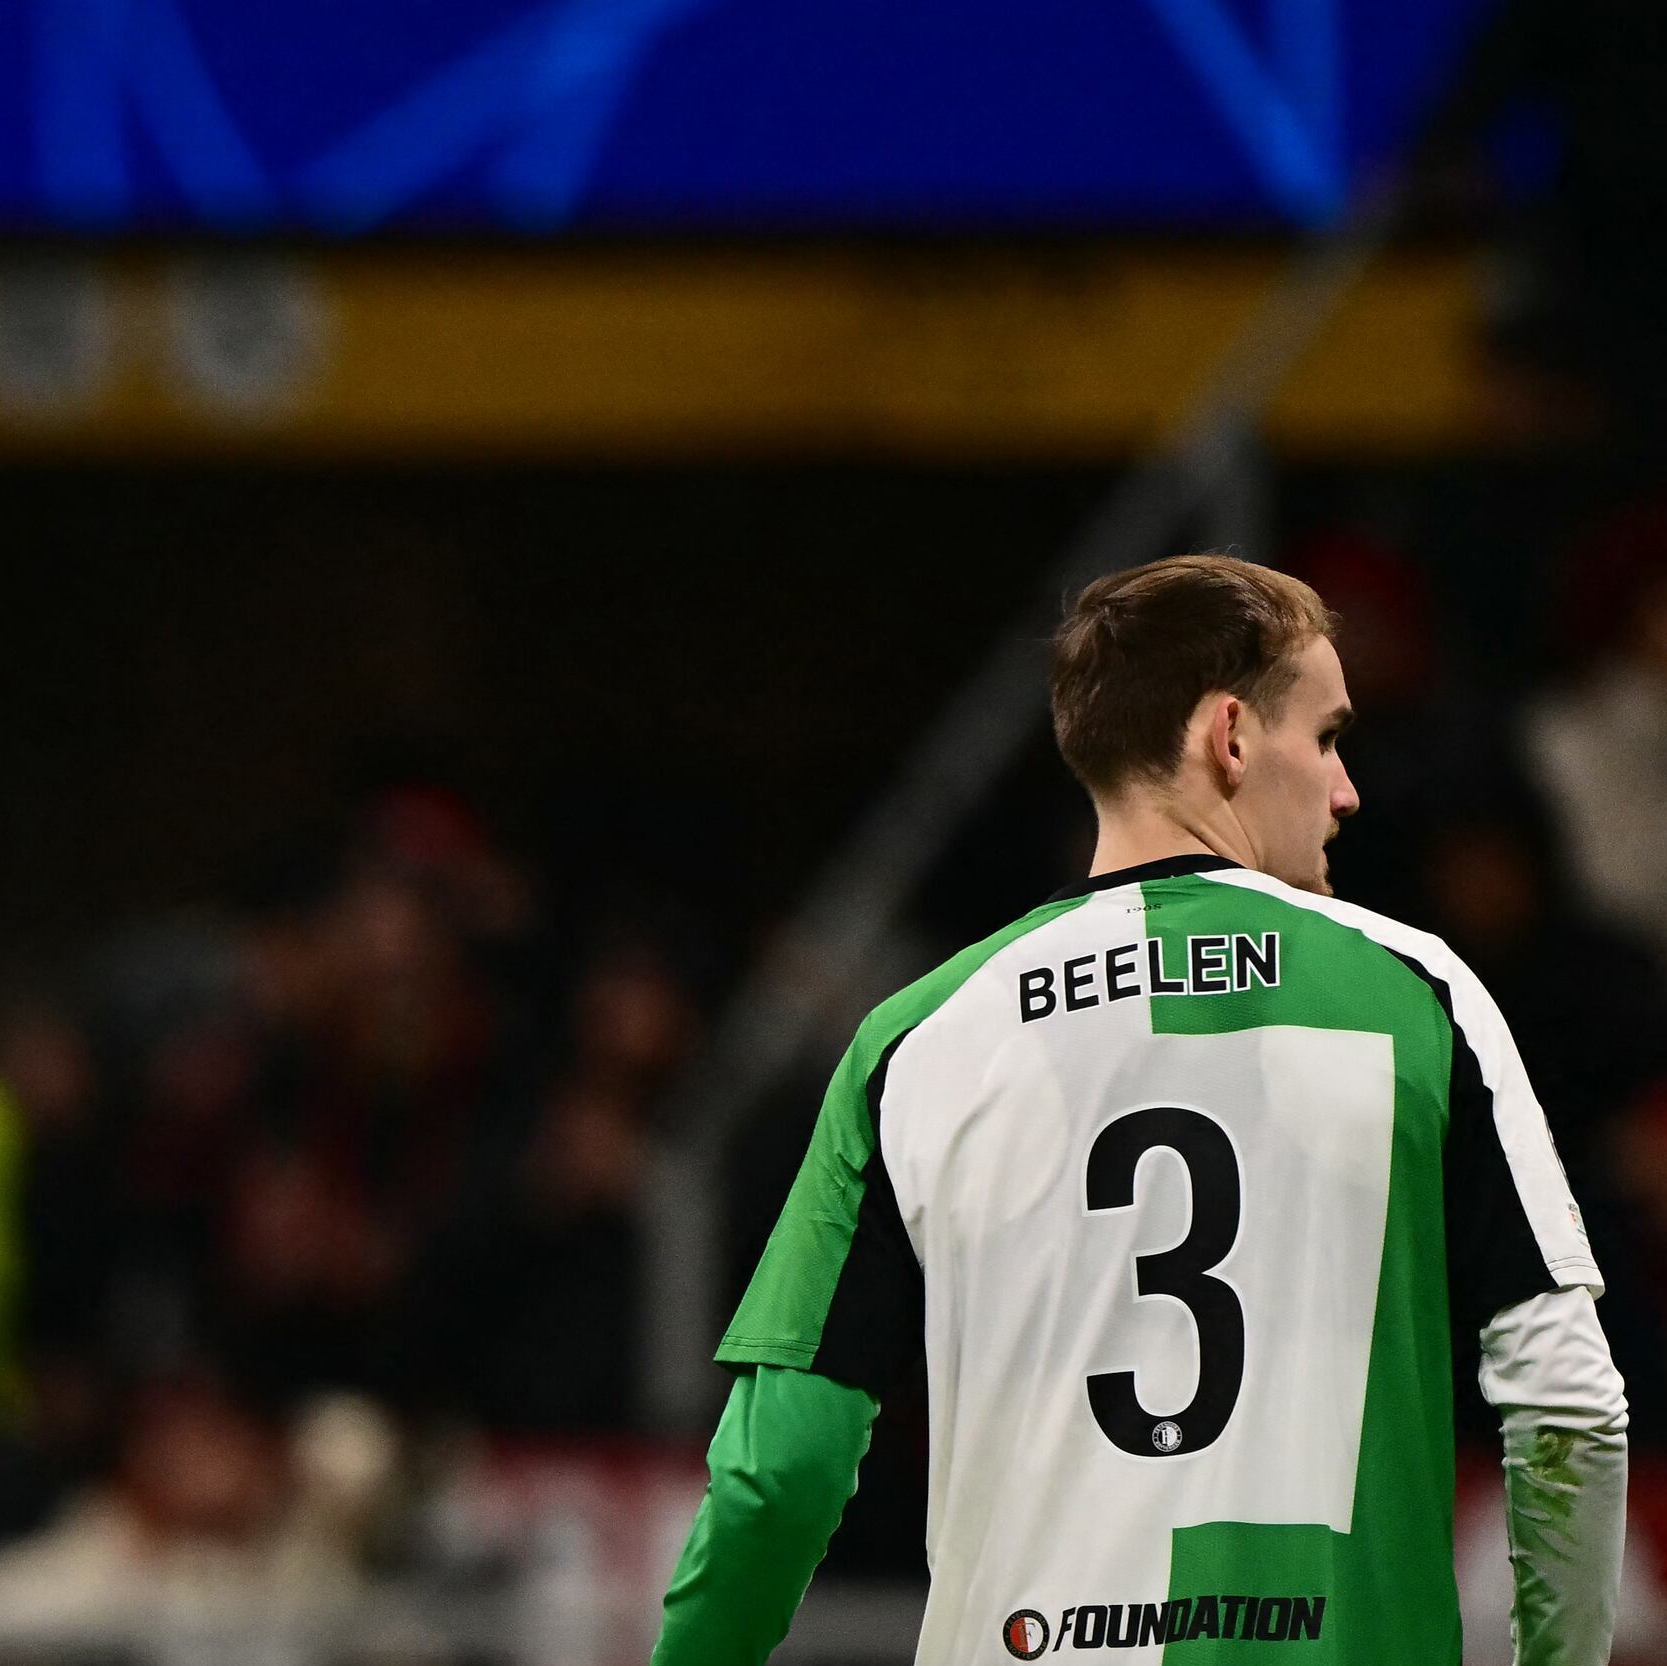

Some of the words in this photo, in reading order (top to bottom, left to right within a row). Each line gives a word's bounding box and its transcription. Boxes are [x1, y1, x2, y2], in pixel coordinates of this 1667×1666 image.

[1018, 931, 1281, 1025] BEELEN
[1083, 1103, 1248, 1459] 3
[1052, 1594, 1327, 1652] FOUNDATION
